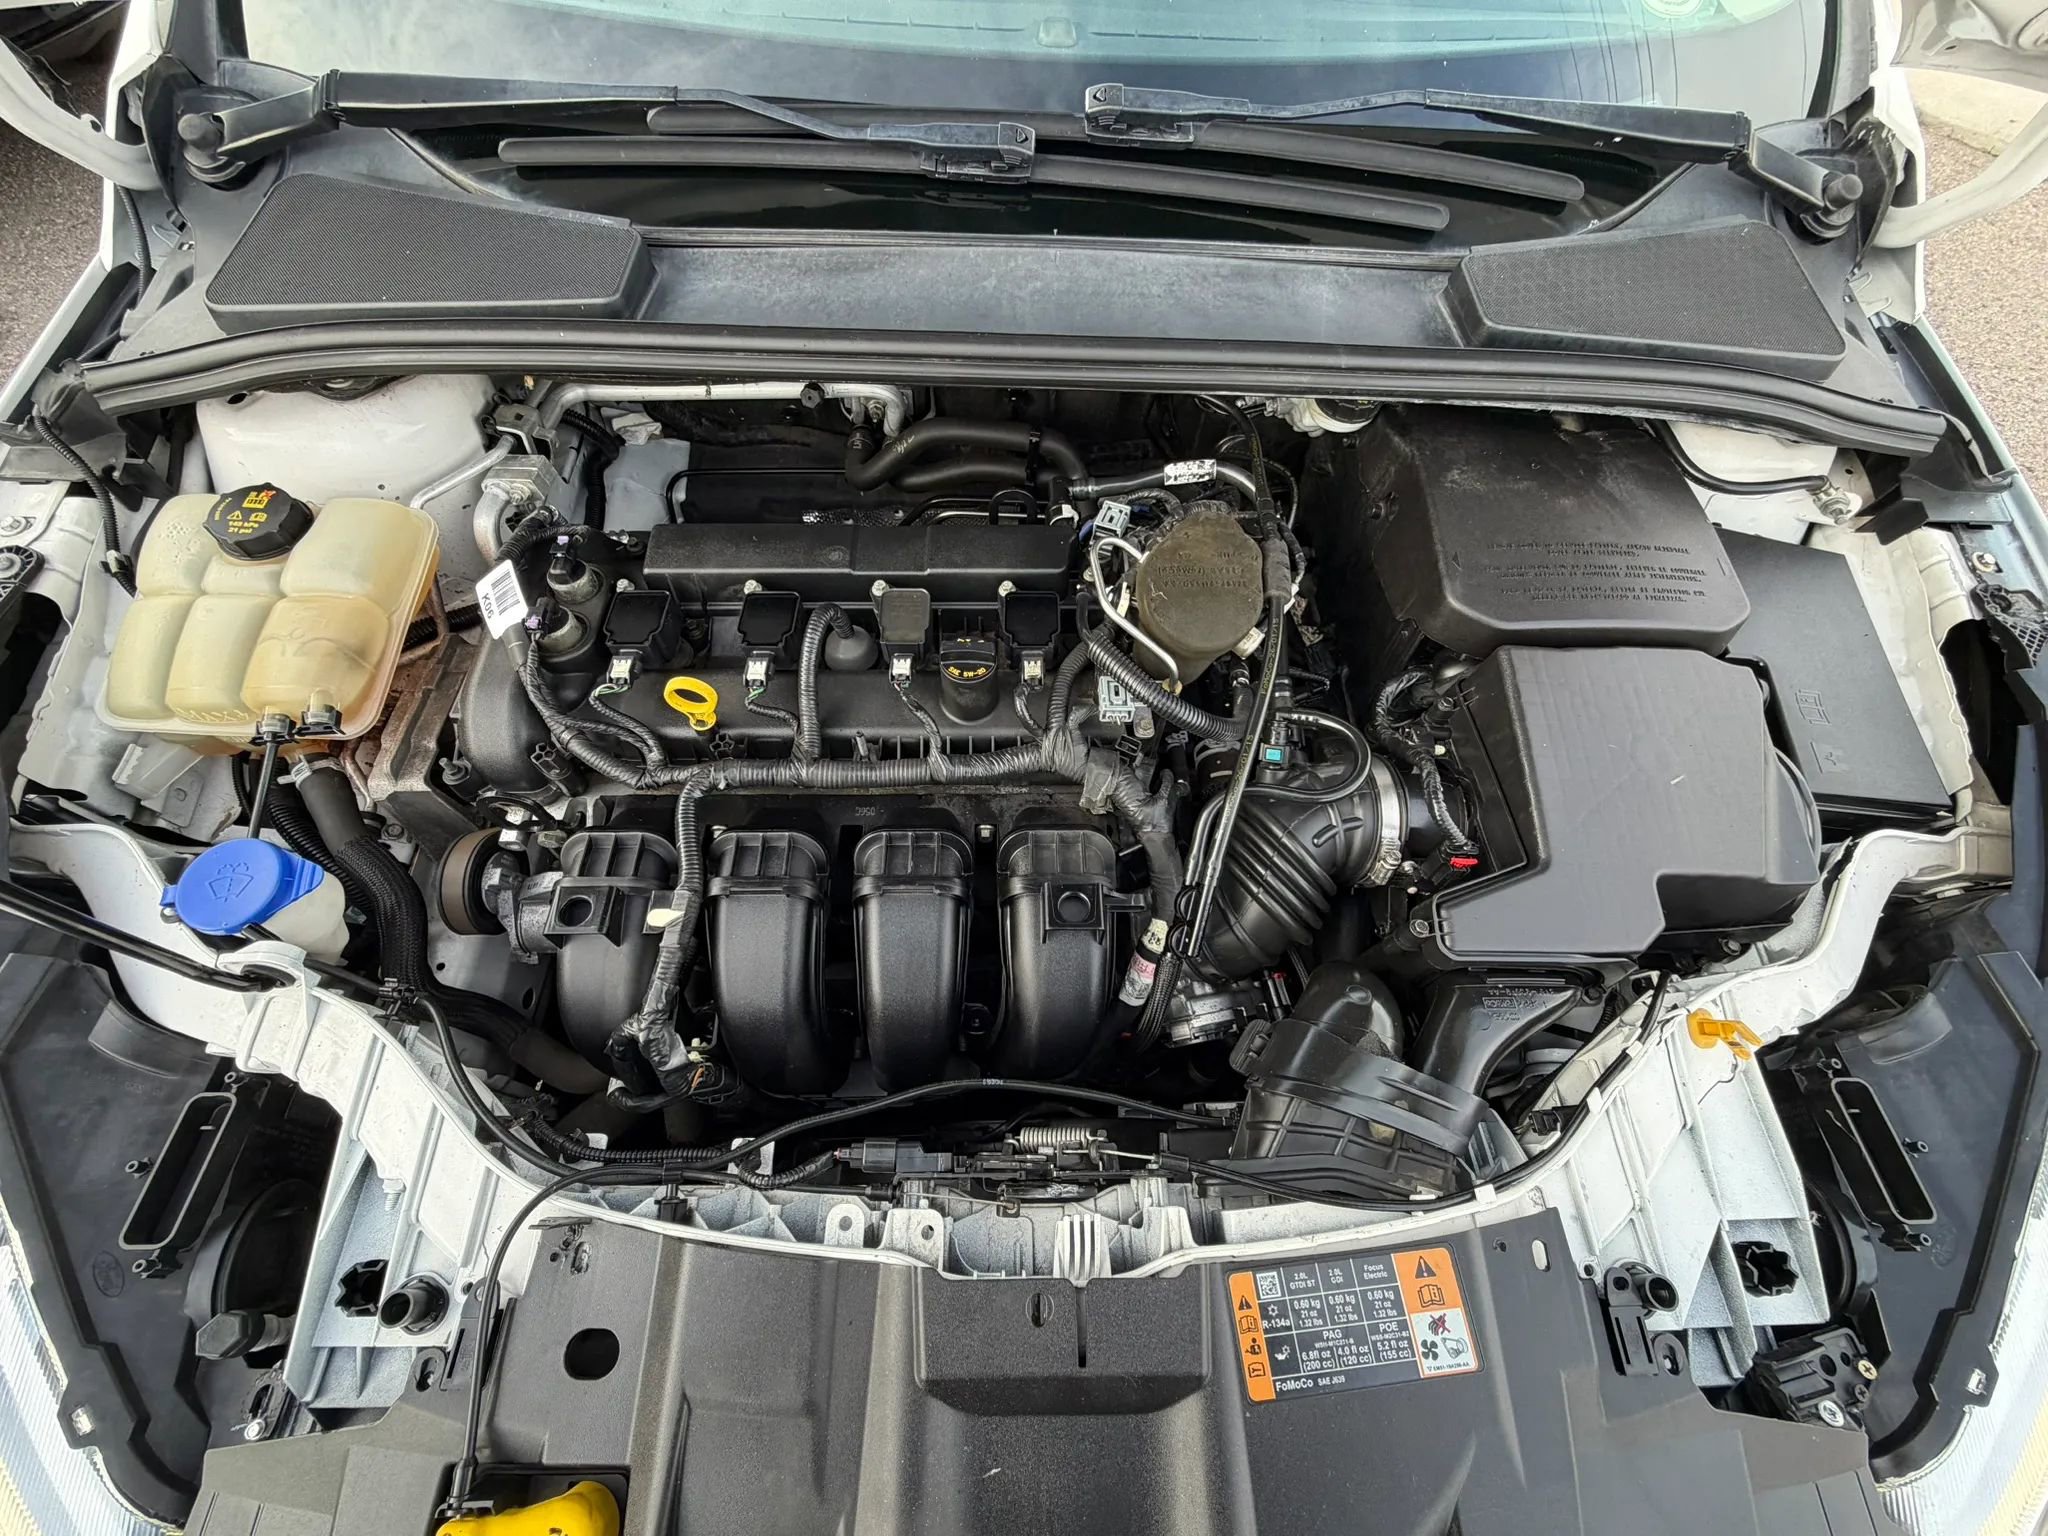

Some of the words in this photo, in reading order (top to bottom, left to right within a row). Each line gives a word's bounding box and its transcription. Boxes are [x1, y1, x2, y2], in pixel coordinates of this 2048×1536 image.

[1363, 1271, 1388, 1280] Electric
[1307, 1280, 1315, 1288] ST
[1328, 1294, 1344, 1305] 0.60
[1345, 1294, 1355, 1304] kg
[1367, 1290, 1383, 1300] 0.60
[1384, 1289, 1394, 1300] kg
[1294, 1299, 1309, 1309] 0.60
[1310, 1298, 1320, 1309] kg
[1374, 1301, 1382, 1309] 21
[1301, 1310, 1308, 1318] 21
[1335, 1305, 1343, 1314] 21
[1373, 1310, 1386, 1318] 1.32
[1299, 1319, 1312, 1327] 1.32
[1313, 1318, 1323, 1326] lbs
[1334, 1314, 1347, 1322] 1.32
[1348, 1313, 1358, 1321] lbs
[1262, 1318, 1290, 1329] R-134a
[1379, 1322, 1398, 1332] POE
[1323, 1329, 1342, 1340] PAG
[1338, 1346, 1350, 1355] 4.0
[1351, 1345, 1357, 1353] fl
[1377, 1341, 1389, 1350] 5.2
[1391, 1340, 1397, 1349] fl
[1321, 1350, 1331, 1358] oz
[1380, 1350, 1397, 1362] (155
[1399, 1348, 1411, 1358] cc)
[1303, 1360, 1320, 1372] (200
[1322, 1358, 1335, 1368] cc)
[1340, 1356, 1357, 1368] (120
[1359, 1354, 1372, 1364] cc)
[1275, 1378, 1313, 1392] FoMoCo
[1318, 1377, 1331, 1386] SAE
